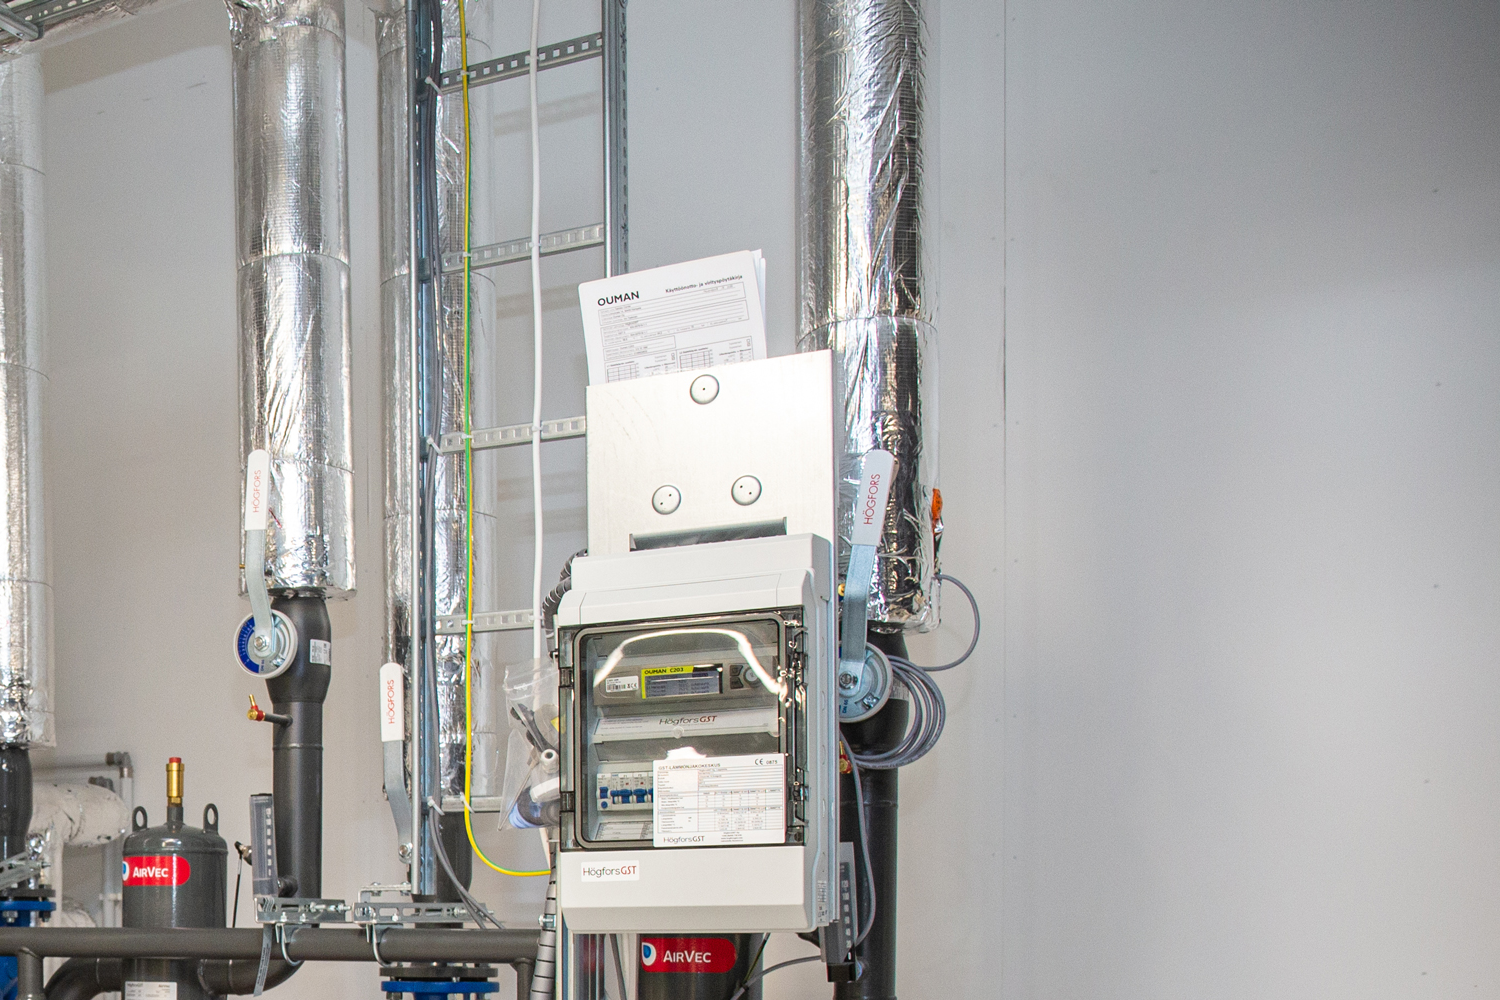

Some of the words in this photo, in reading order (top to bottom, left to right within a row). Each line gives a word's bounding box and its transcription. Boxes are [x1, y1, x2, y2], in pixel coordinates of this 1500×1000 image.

[597, 290, 640, 306] OUMAN
[252, 469, 262, 513] HÖGFORS
[862, 473, 881, 525] HÖGFORS
[582, 865, 637, 878] HögforsGST
